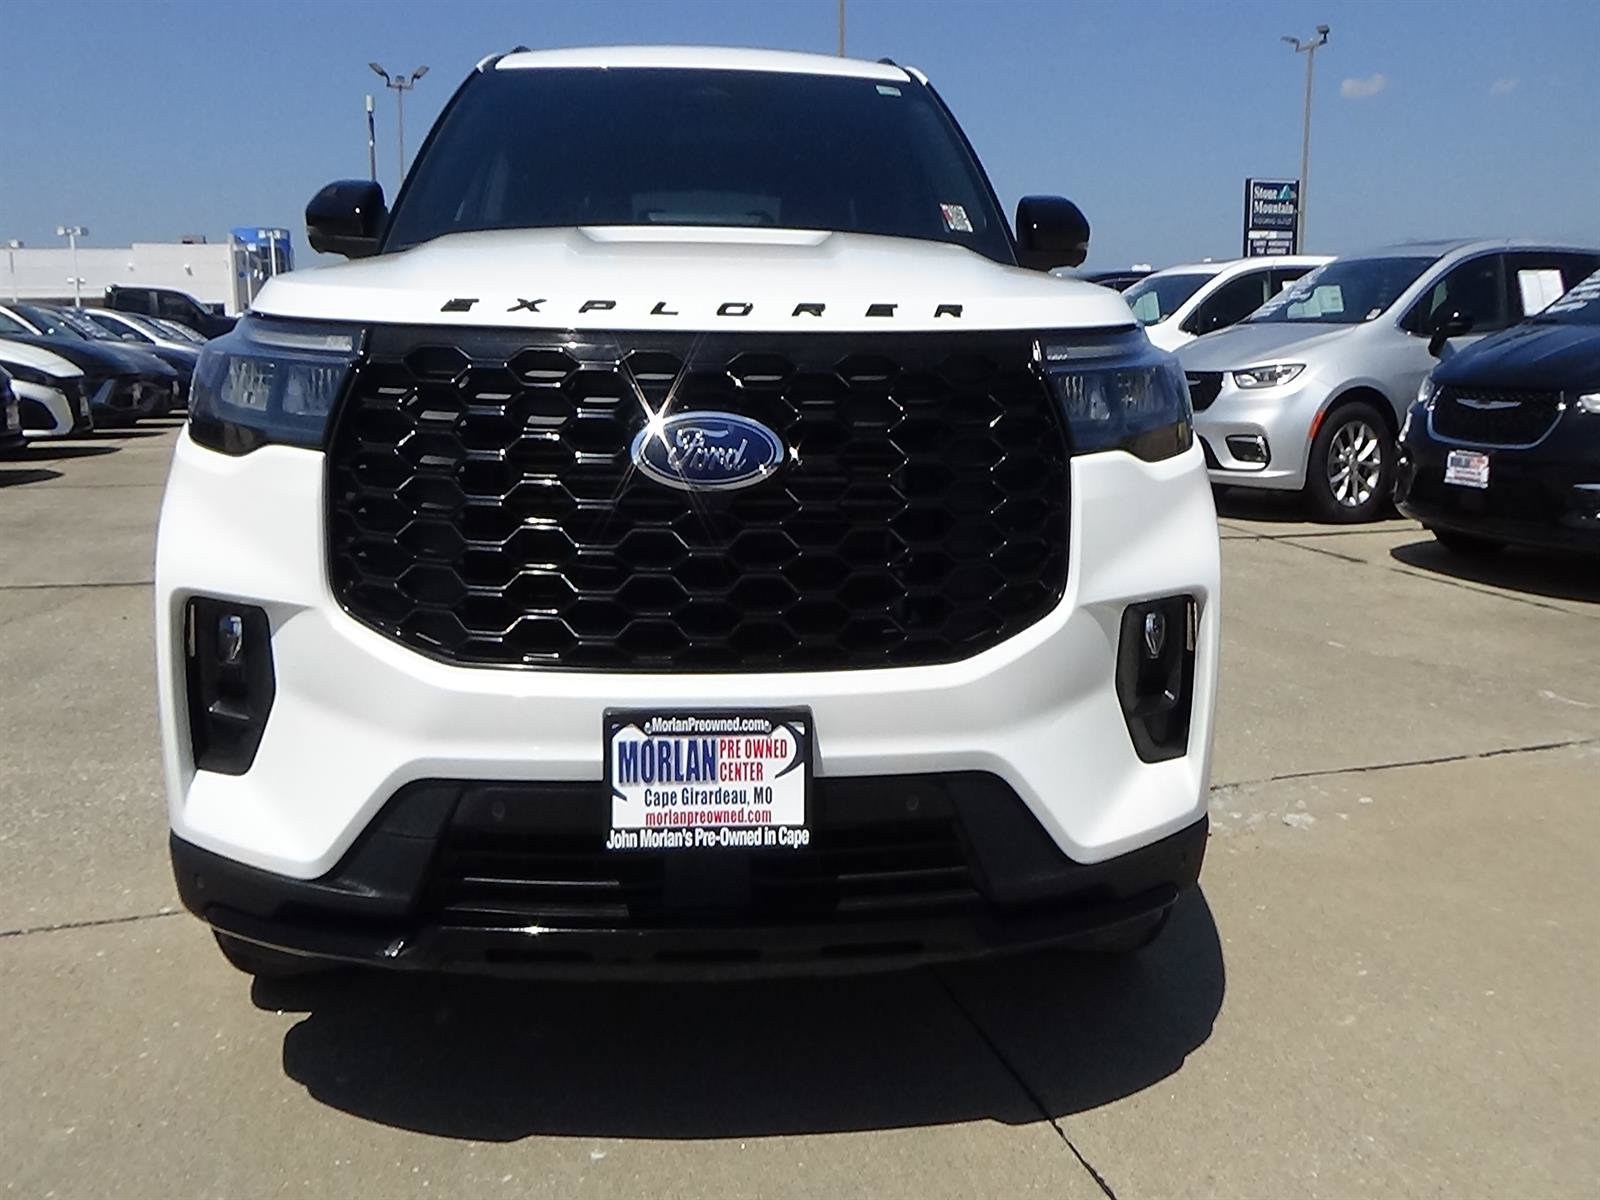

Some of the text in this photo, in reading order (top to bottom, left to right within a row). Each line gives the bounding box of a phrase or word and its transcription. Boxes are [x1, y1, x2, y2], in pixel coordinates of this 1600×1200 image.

[1254, 200, 1294, 214] Mountain
[440, 298, 964, 319] EXPLORER
[667, 427, 749, 472] Ford
[651, 717, 766, 732] MorlanPreowned.com
[720, 738, 788, 759] PRE OWNED
[618, 738, 717, 785] MORLAN
[720, 762, 764, 782] CENTER
[644, 786, 773, 808] Cape Girardeau, MO
[645, 808, 772, 827] morlanpreowned.com
[606, 826, 810, 849] John Morlan's Pre-Owned in Cape
